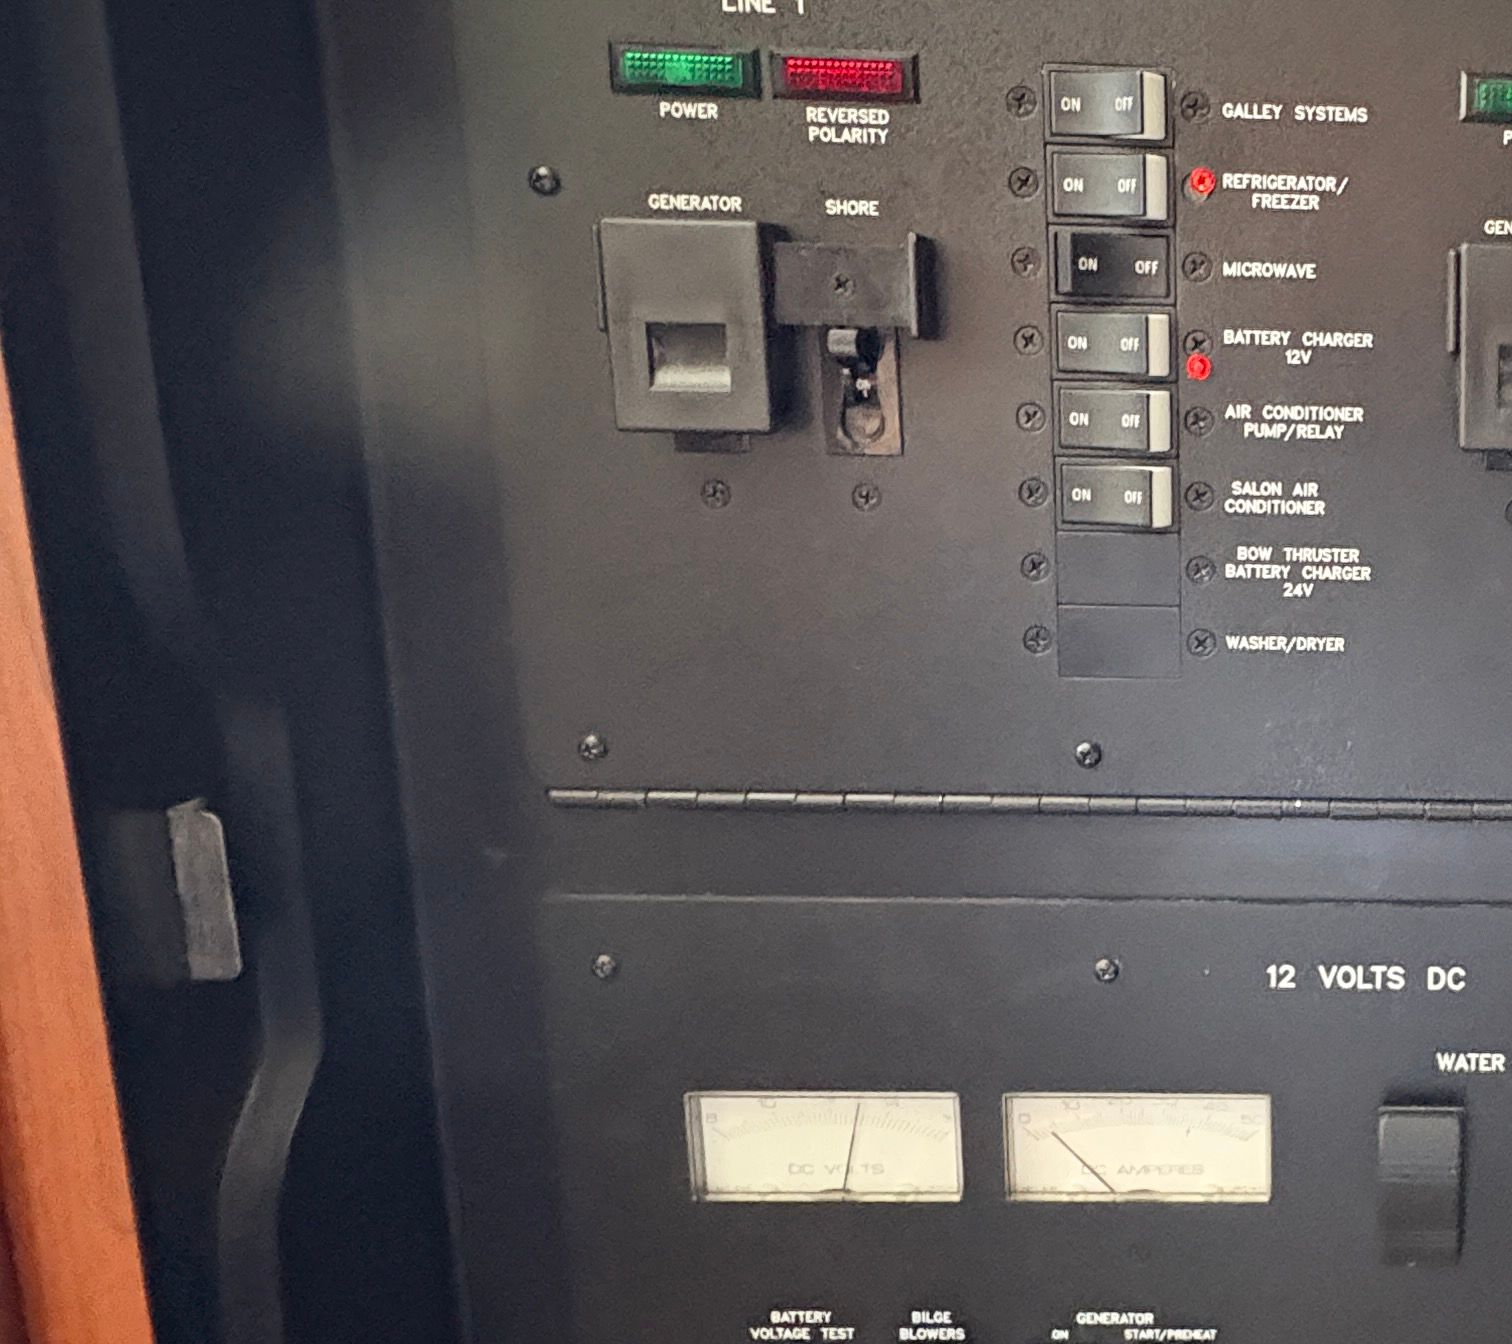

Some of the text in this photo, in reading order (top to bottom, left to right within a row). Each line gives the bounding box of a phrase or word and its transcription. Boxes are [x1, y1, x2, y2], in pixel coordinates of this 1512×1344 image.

[660, 102, 718, 119] POWER
[1061, 97, 1133, 111] ON OFF
[806, 107, 890, 126] REVERSED
[1222, 103, 1368, 122] GALLEY SYSTEMS
[808, 126, 888, 144] POLARITY
[1064, 178, 1136, 192] ON OFF
[1223, 173, 1349, 196] REFRIGERATOR/
[648, 194, 742, 212] GENERATOR
[825, 199, 879, 216] SHORE
[1252, 193, 1320, 210] FREEZER
[1078, 257, 1158, 274] ON OFF
[1223, 262, 1317, 279] MICROWAVE
[1068, 336, 1139, 352] ON OFF
[1224, 329, 1373, 348] BATTERY CHARGER
[1285, 349, 1312, 364] 12V
[1069, 412, 1140, 428] ON OFF
[1225, 404, 1364, 423] AIR CONDITIONER
[1244, 425, 1345, 441] PUMP/RELAY
[1072, 488, 1142, 504] ON OFF
[1232, 481, 1319, 497] SALON AIR
[1224, 499, 1325, 515] CONDITIONER
[1237, 546, 1359, 563] BOW THRUSTER
[1225, 564, 1371, 581] BATTERY CHARGER
[1283, 582, 1314, 597] 24V
[1226, 636, 1344, 653] WASHER/DRYER
[1266, 965, 1466, 991] 12 VOLTS DC
[1436, 1052, 1505, 1072] WATER
[771, 1311, 832, 1323] BATTERY
[911, 1311, 952, 1324] BILGE
[1076, 1312, 1154, 1325] GENERATOR
[750, 1327, 854, 1340] VOLTAGE TEST
[899, 1328, 966, 1341] BLOWERS
[1051, 1329, 1069, 1340] ON
[1124, 1329, 1217, 1341] START/PREHEAT
